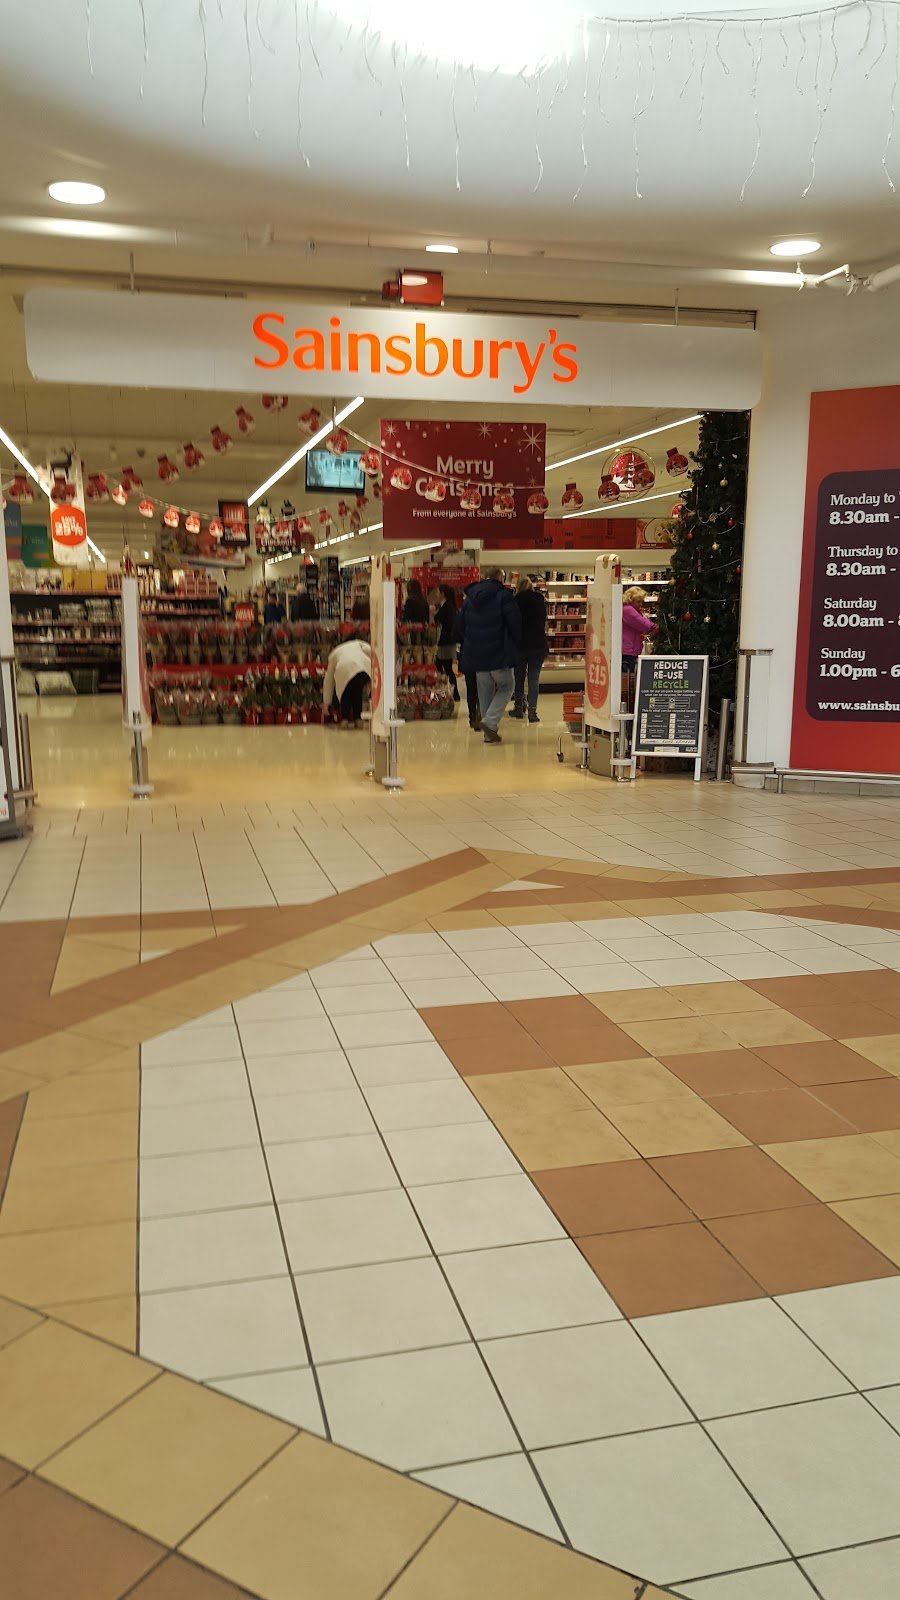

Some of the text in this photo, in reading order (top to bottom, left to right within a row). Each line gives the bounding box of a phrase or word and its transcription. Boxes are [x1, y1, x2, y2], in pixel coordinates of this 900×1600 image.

[252, 311, 579, 394] Sainsbury's
[436, 455, 494, 479] Merry
[830, 493, 880, 506] Monday
[884, 493, 896, 504] to
[412, 509, 431, 518] From
[433, 510, 467, 519] everyone
[467, 510, 475, 518] at
[829, 510, 890, 525] 8.30am
[828, 545, 899, 559] Thursday to
[826, 562, 886, 577] 8.30am
[824, 597, 877, 611] Saturday
[822, 614, 885, 628] 8.00am
[820, 647, 866, 661] Sunday
[654, 661, 688, 670] REDUCE
[819, 664, 877, 680] 1.00pm
[588, 663, 607, 686] £15
[653, 671, 684, 679] RE-USE
[652, 680, 689, 689] RECYCLE
